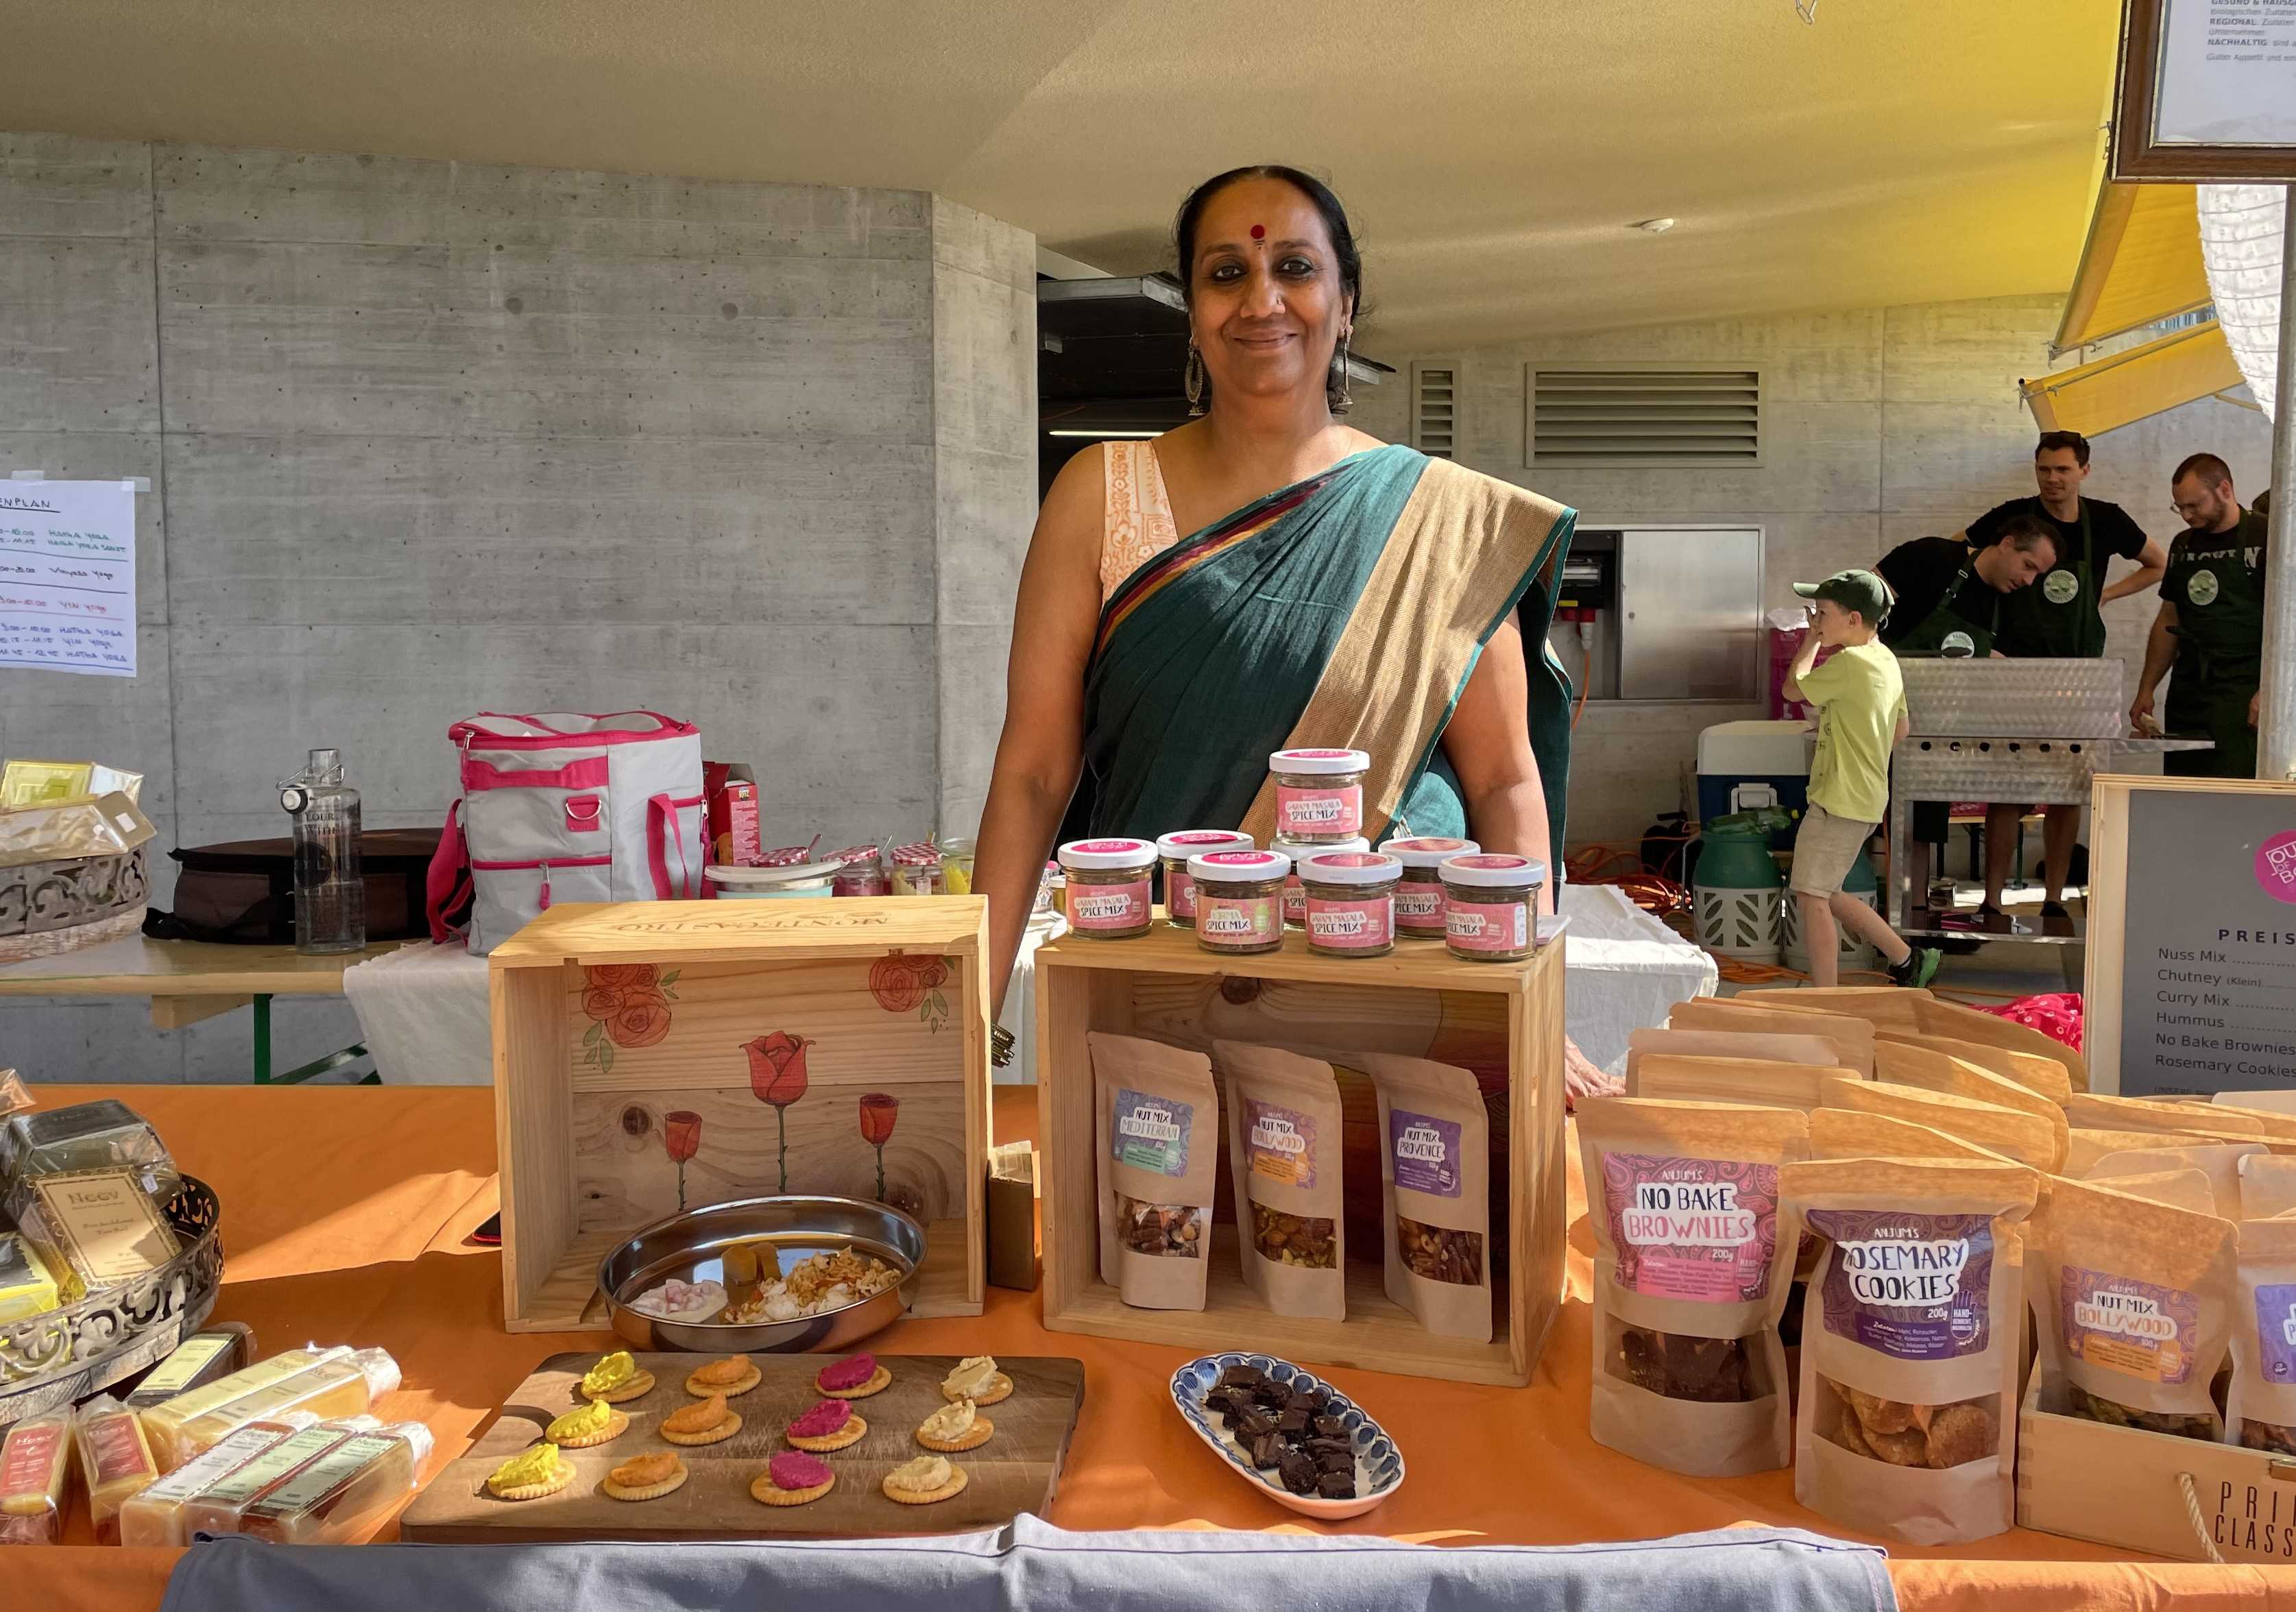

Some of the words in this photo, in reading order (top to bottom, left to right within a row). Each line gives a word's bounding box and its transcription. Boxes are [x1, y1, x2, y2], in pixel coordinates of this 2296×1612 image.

[1292, 810, 1313, 820] SPICE
[1316, 810, 1336, 819] MIX
[1290, 898, 1305, 906] SPIC
[1394, 904, 1412, 913] PICE
[1413, 904, 1434, 913] MIX
[1080, 906, 1101, 917] SPICE
[1104, 905, 1124, 915] MIX
[1207, 920, 1227, 930] SPICE
[1230, 920, 1249, 930] MIX
[1315, 923, 1334, 933] SPICE
[1338, 922, 1360, 932] MIX
[1459, 924, 1478, 933] MIX
[2219, 929, 2295, 945] PREIS
[2158, 948, 2195, 961] Nuss
[2200, 950, 2227, 963] Mix
[2158, 969, 2222, 987] Chutney
[2227, 976, 2261, 987] (Klein)
[2157, 991, 2198, 1007] Curry
[2204, 994, 2230, 1007] Mix
[2156, 1012, 2225, 1028] Hummus
[2156, 1033, 2176, 1046] No
[2182, 1035, 2220, 1049] Bake
[2225, 1039, 2296, 1056] Brownies
[2155, 1055, 2232, 1074] Rosemary
[2237, 1061, 2296, 1078] Cookies
[1136, 1109, 1152, 1121] NUT
[1153, 1112, 1170, 1123] MIX
[1277, 1122, 1292, 1134] MIX
[1407, 1130, 1421, 1140] NUT
[1422, 1131, 1438, 1142] MIX
[1399, 1141, 1442, 1159] PROVENCE
[1662, 1170, 1703, 1181] ANJUM'S
[67, 1190, 119, 1205] Neev
[1642, 1188, 1671, 1210] NO
[1678, 1188, 1734, 1211] BAKE
[1628, 1214, 1750, 1240] BROWNIES
[1874, 1228, 1920, 1239] ANJUM'S
[1712, 1249, 1734, 1263] 200g
[1846, 1243, 1964, 1271] OSEMARY
[1855, 1273, 1957, 1301] COOKIES
[2096, 1295, 2124, 1310] NUT
[2127, 1299, 2154, 1314] MIX
[1927, 1307, 1948, 1321] 200g
[2079, 1306, 2173, 1336] BOLLYWOOD
[2221, 1481, 2296, 1528] PRI
[2215, 1515, 2293, 1557] CLASS
